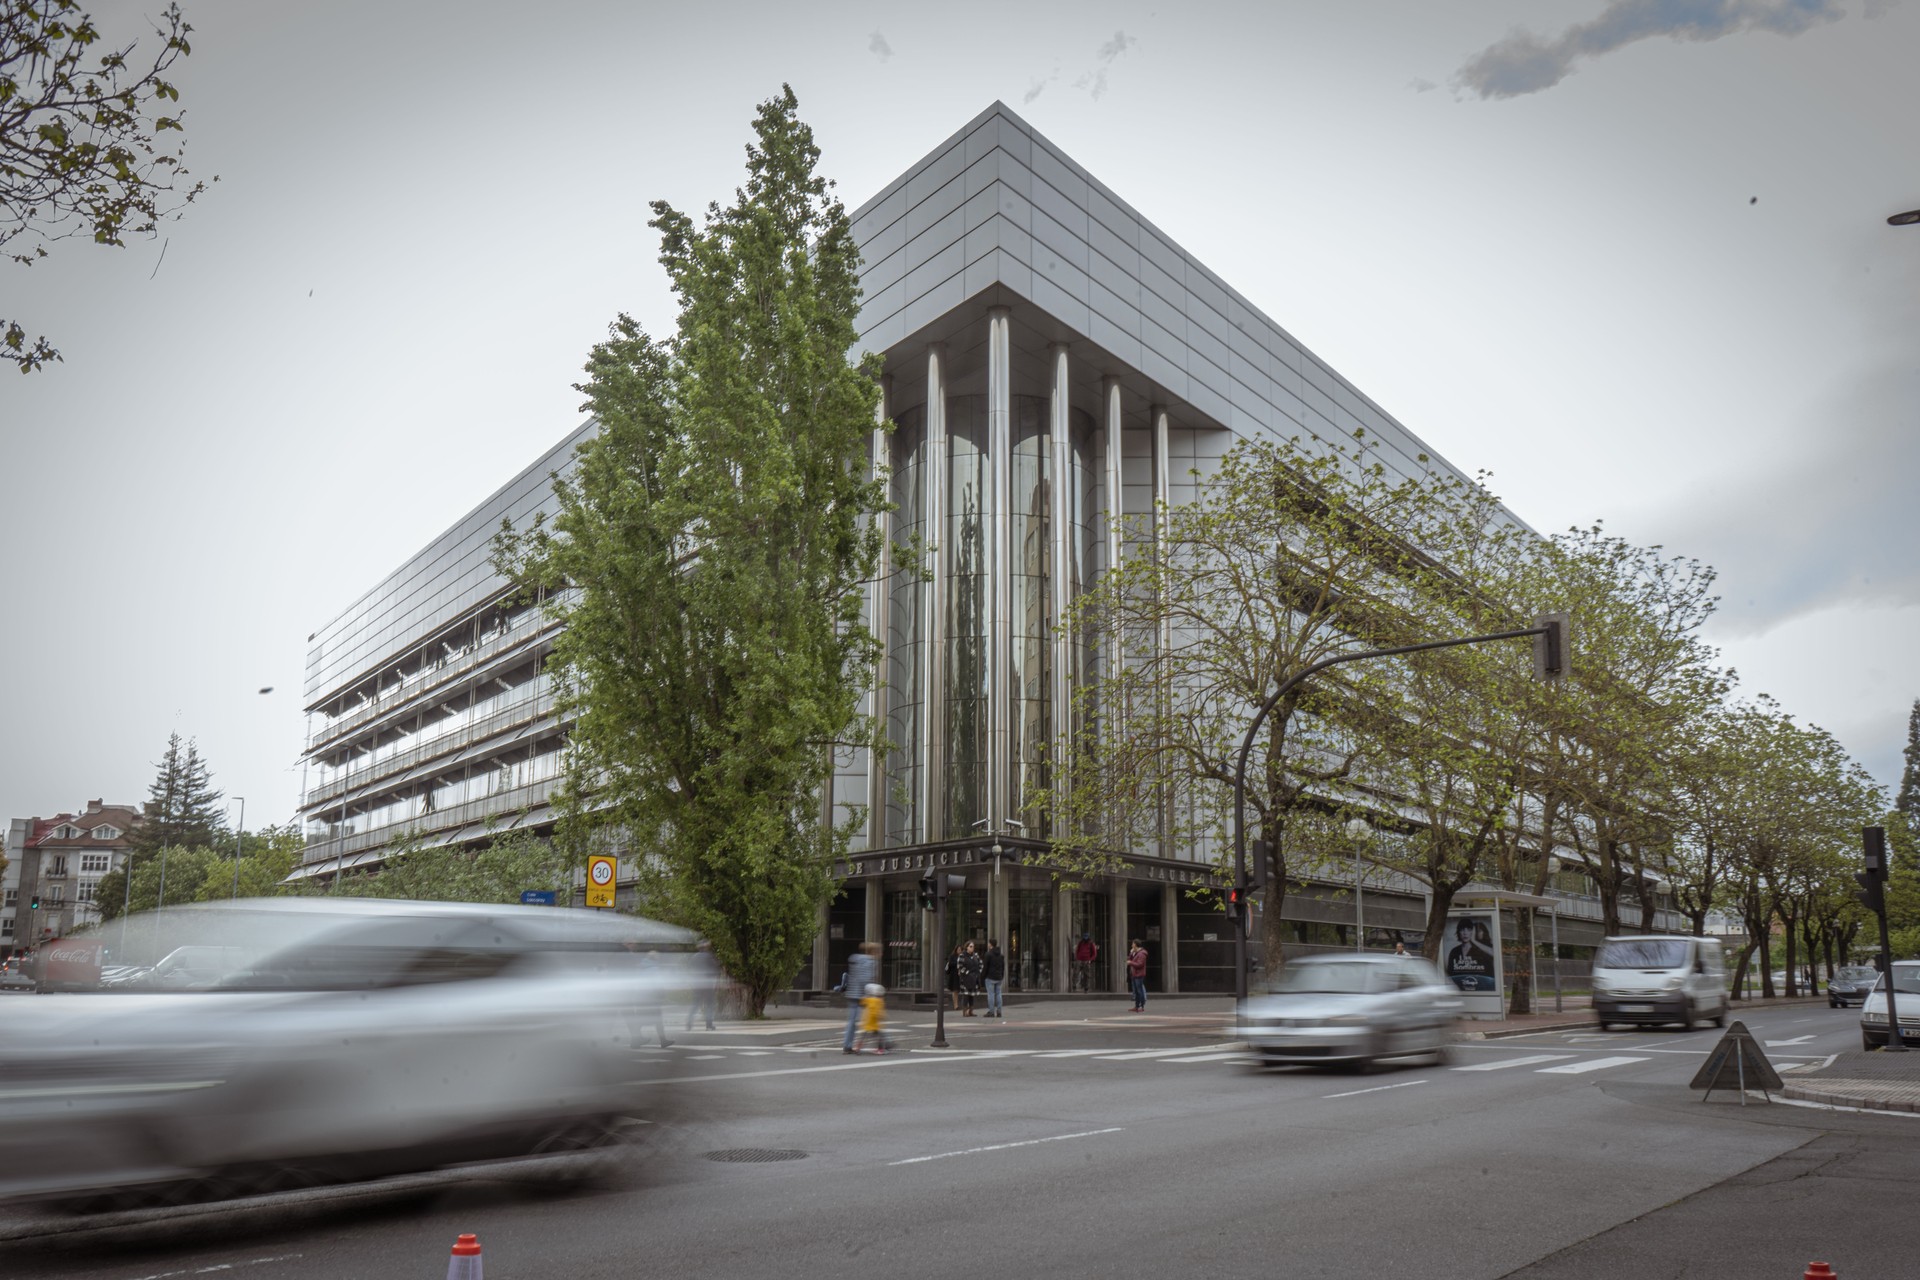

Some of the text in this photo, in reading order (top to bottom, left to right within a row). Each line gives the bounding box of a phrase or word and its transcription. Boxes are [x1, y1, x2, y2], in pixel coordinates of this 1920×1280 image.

[848, 862, 864, 875] DE
[880, 850, 973, 872] JUSTICIA
[595, 866, 609, 879] 30
